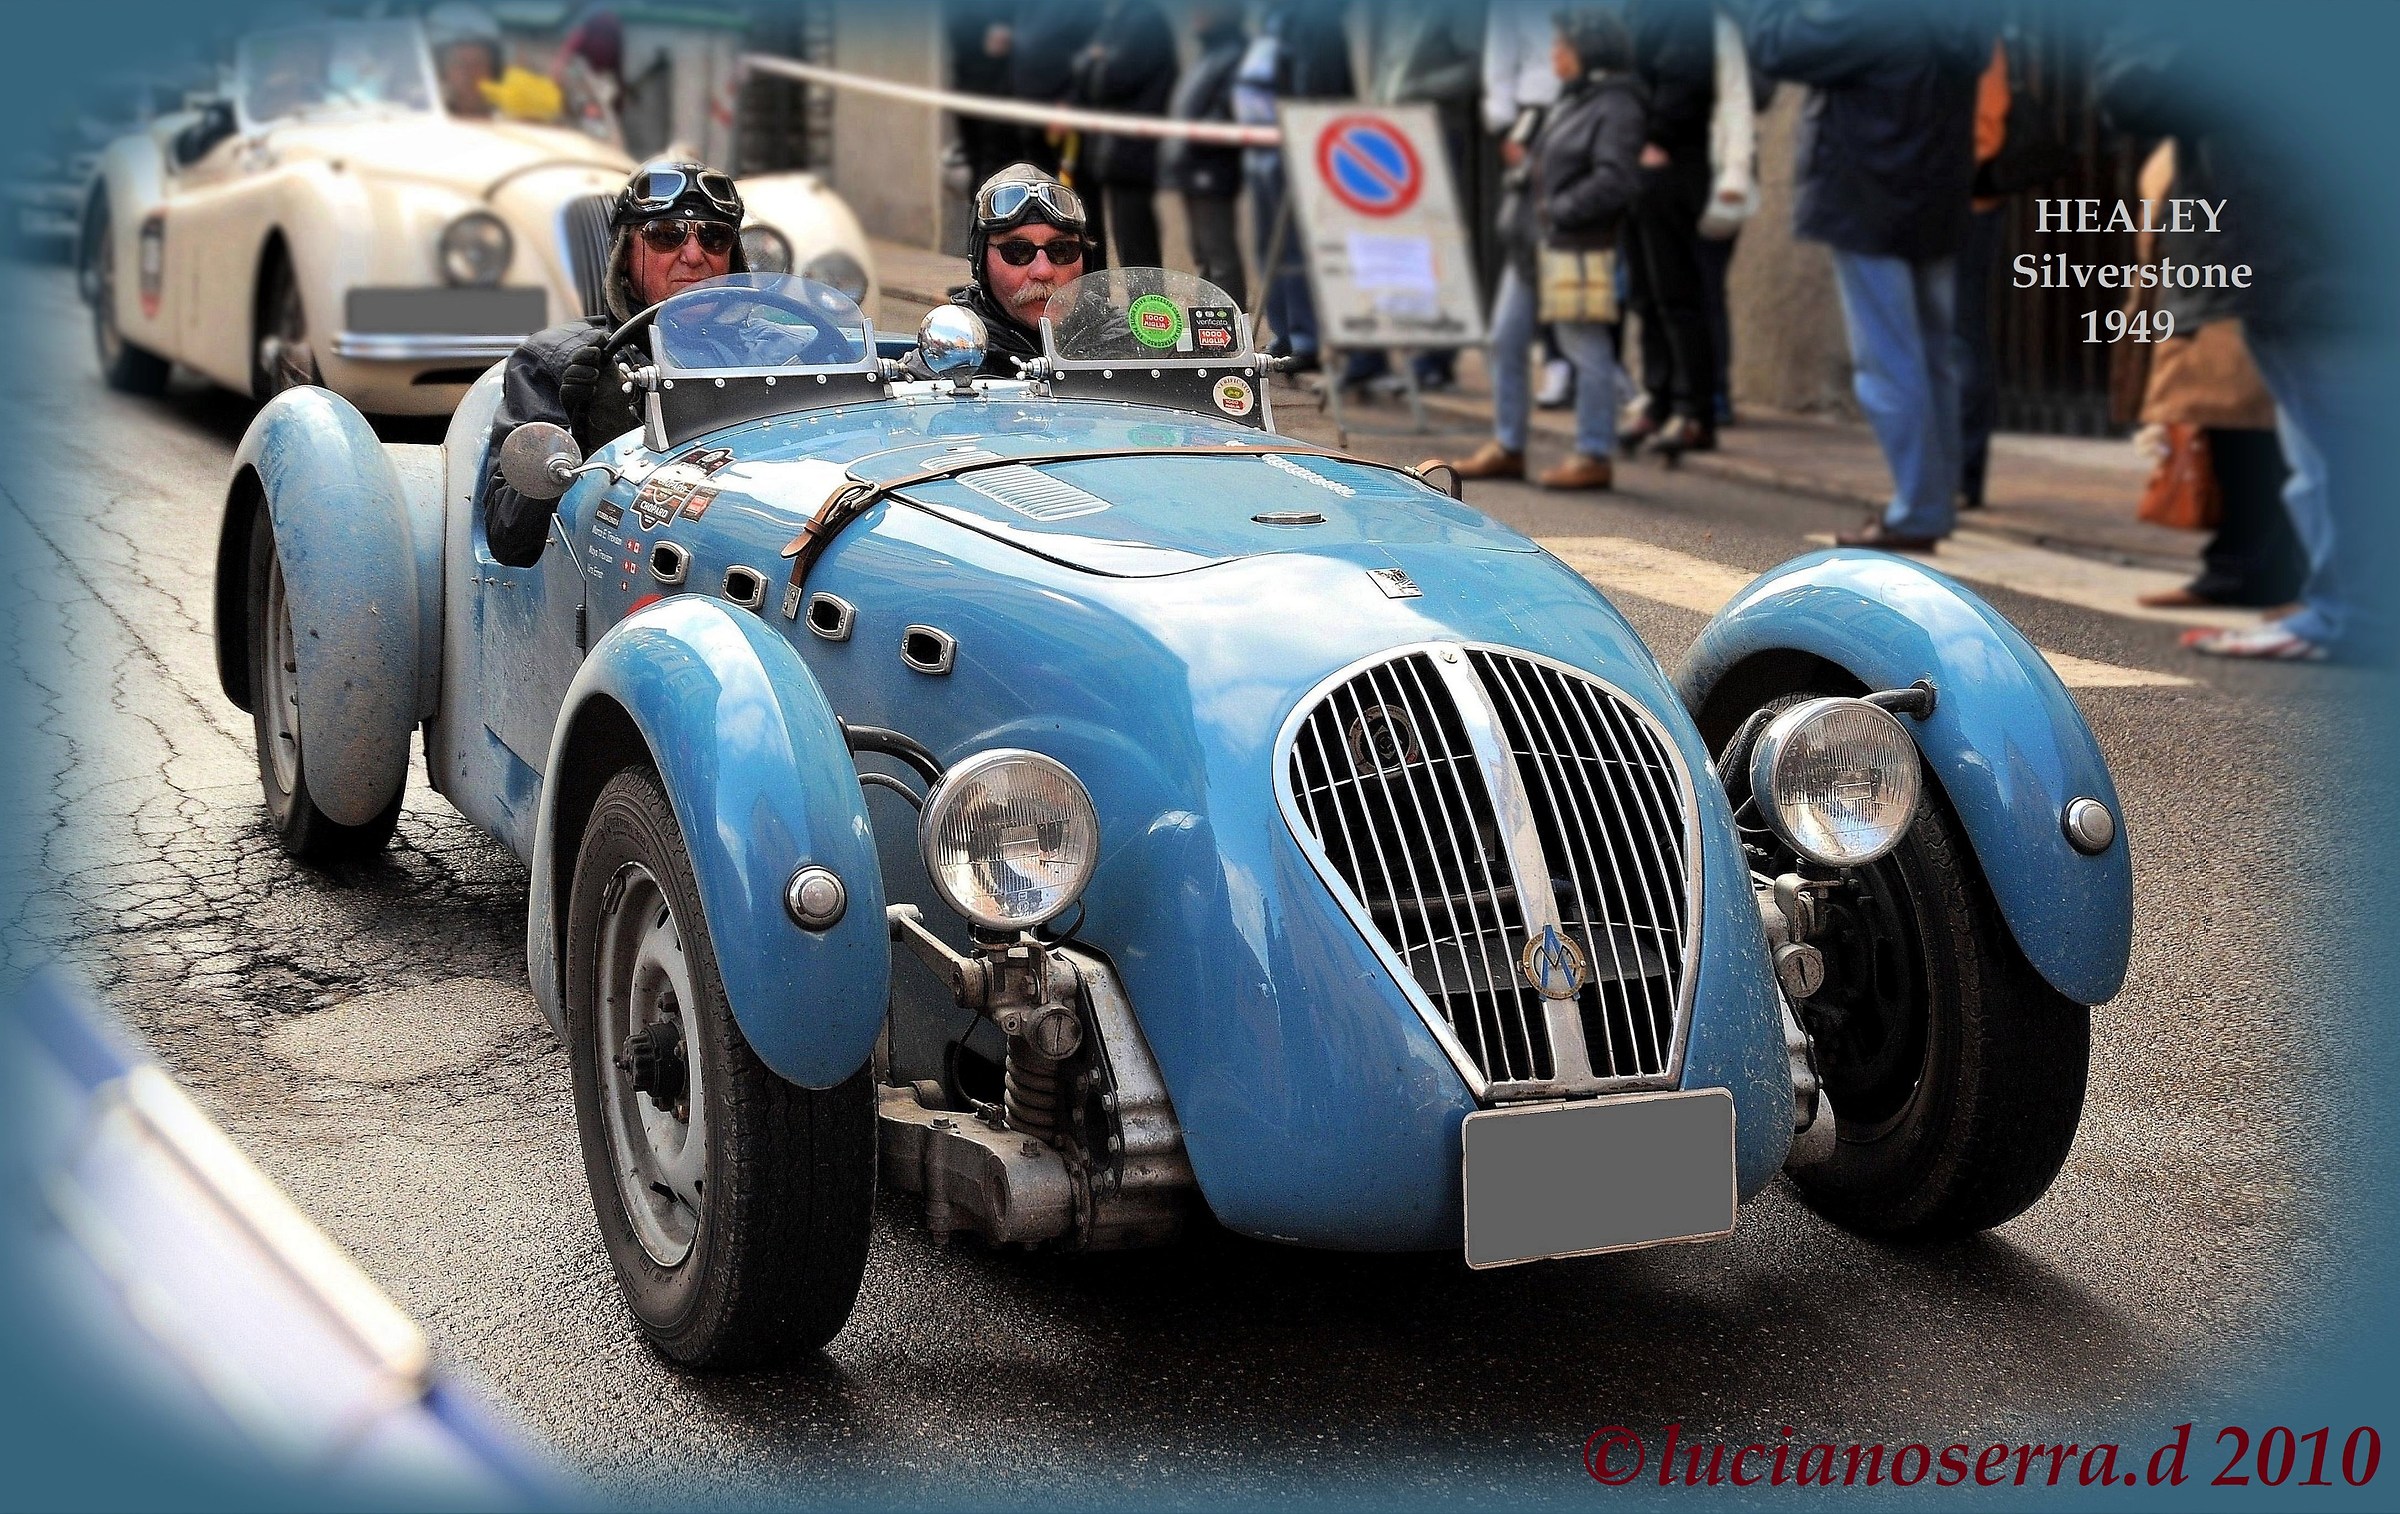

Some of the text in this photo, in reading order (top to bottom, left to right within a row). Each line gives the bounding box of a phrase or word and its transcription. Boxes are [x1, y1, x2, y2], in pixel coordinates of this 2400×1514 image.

[1145, 314, 1165, 322] 1000
[1202, 330, 1222, 338] 1000
[640, 500, 669, 518] CHOPARD
